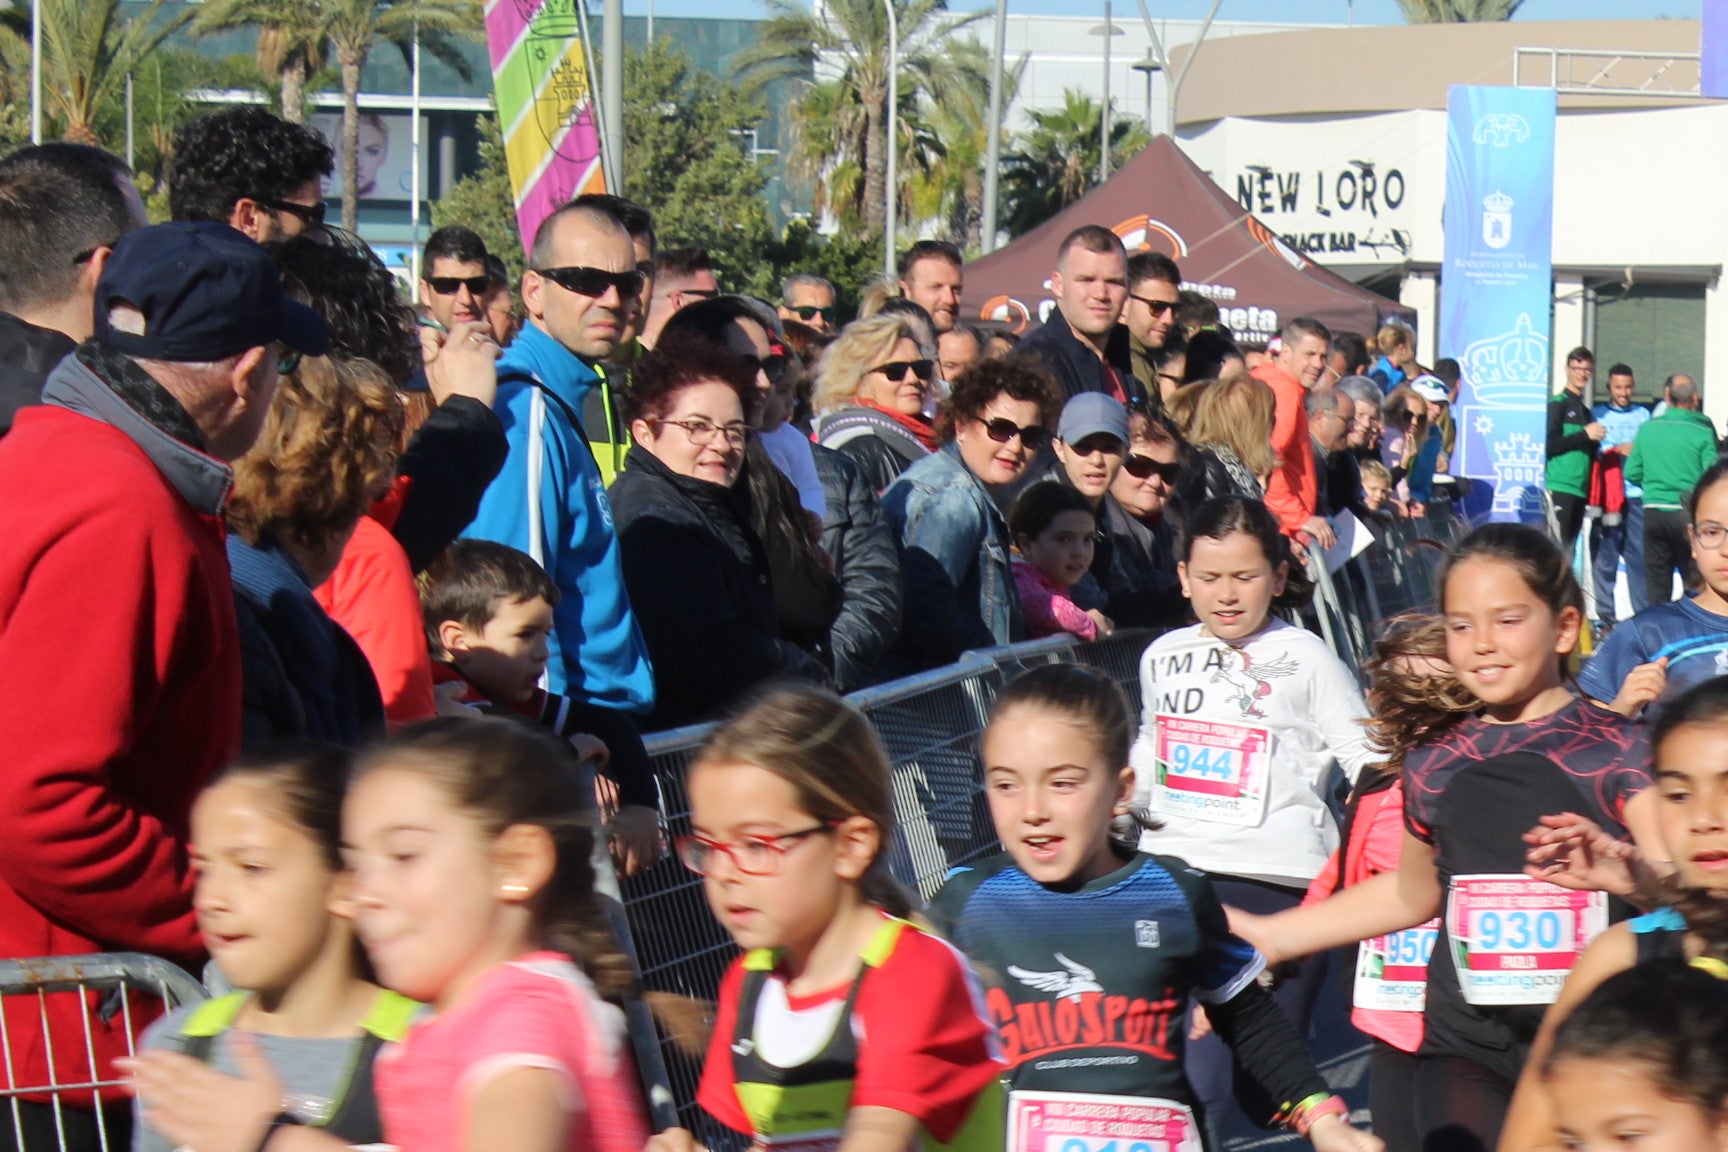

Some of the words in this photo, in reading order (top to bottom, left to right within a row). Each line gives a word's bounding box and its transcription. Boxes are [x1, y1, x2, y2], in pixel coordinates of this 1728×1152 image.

[1238, 168, 1300, 213] NEW
[1316, 164, 1404, 219] LORO
[1330, 232, 1356, 252] BAR
[1151, 652, 1193, 683] I'M
[1173, 744, 1233, 780] 944
[1387, 930, 1438, 963] 950
[1480, 912, 1562, 949] 930
[1066, 1103, 1120, 1119] CARRERA
[1121, 1106, 1171, 1122] POPULAR
